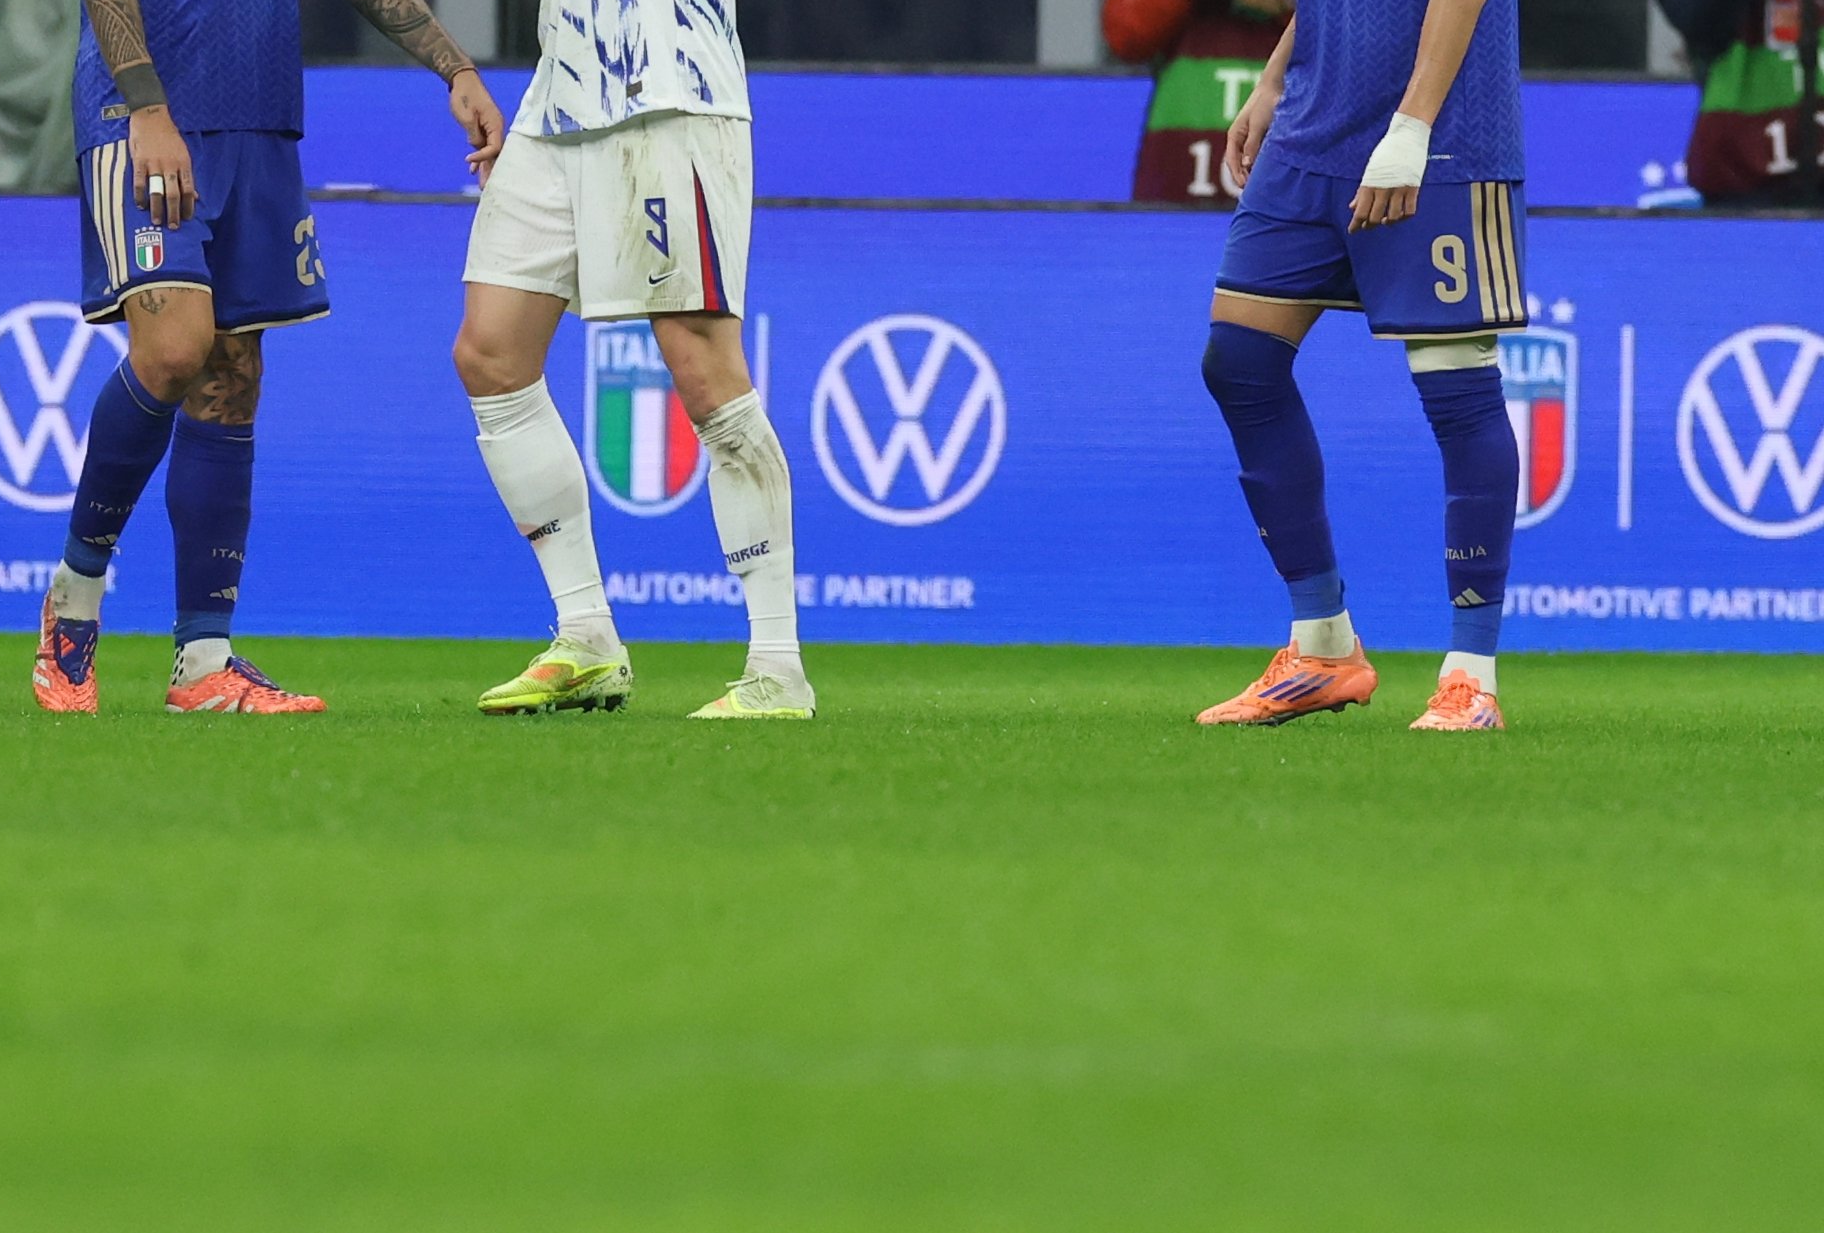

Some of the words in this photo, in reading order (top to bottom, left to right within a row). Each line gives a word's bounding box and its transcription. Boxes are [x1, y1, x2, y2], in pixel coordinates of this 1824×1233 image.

[1215, 68, 1262, 120] T
[294, 214, 327, 286] 2
[644, 197, 670, 259] 9
[1431, 234, 1469, 304] 9
[822, 575, 975, 609] PARTNER
